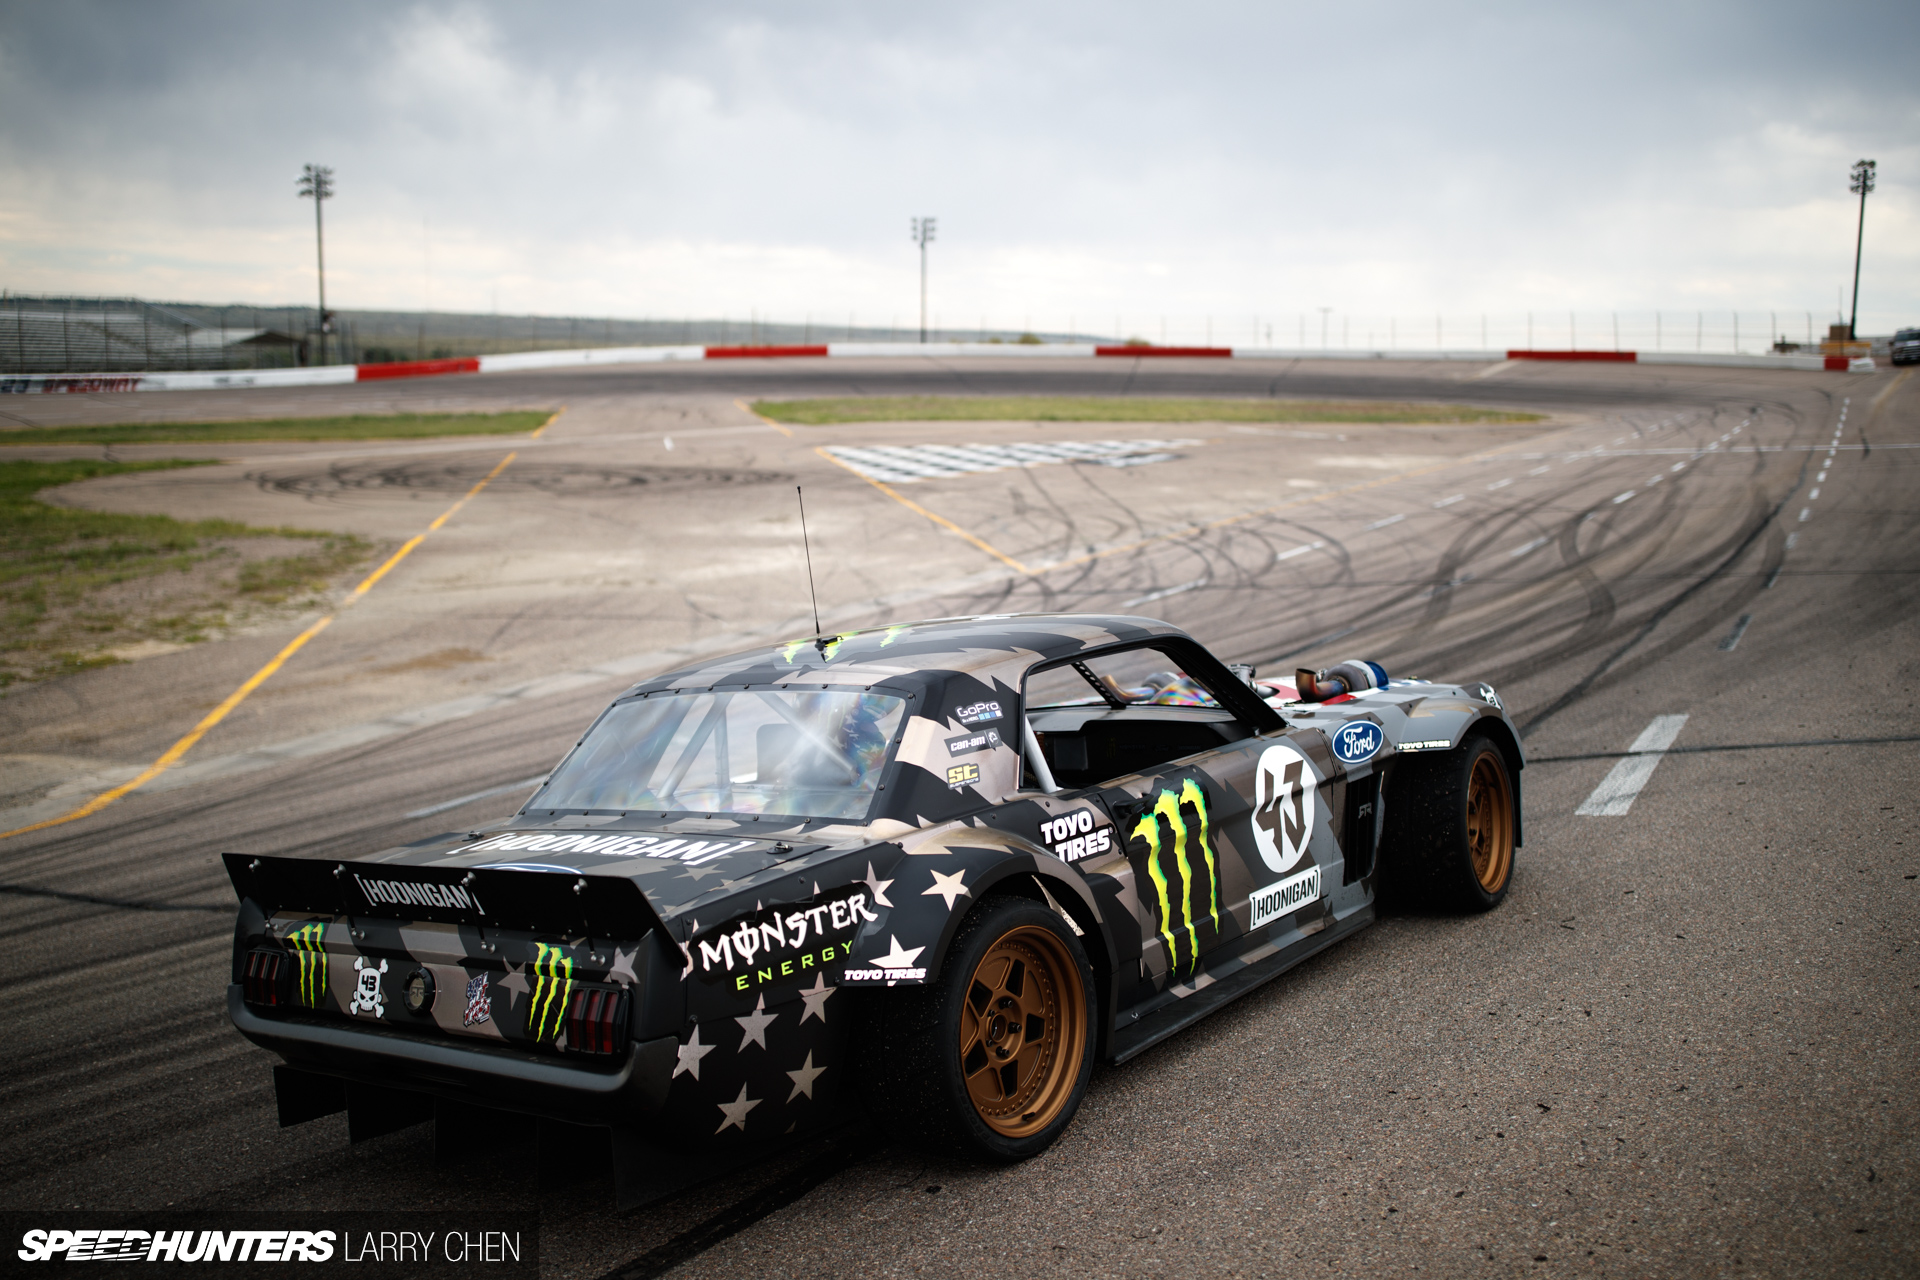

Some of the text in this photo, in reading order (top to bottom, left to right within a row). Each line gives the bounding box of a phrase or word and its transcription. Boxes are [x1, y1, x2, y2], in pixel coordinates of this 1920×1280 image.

[956, 702, 999, 717] GoPro
[950, 736, 986, 752] can-am
[1343, 726, 1375, 758] Ford
[1398, 740, 1450, 750] TOYO TIRES
[1041, 810, 1093, 845] TOYO
[1055, 828, 1111, 863] TIRES
[698, 893, 879, 972] MONSTER
[735, 940, 853, 991] ENERGY
[844, 967, 927, 981] TOYO TIRES
[361, 974, 377, 992] 43
